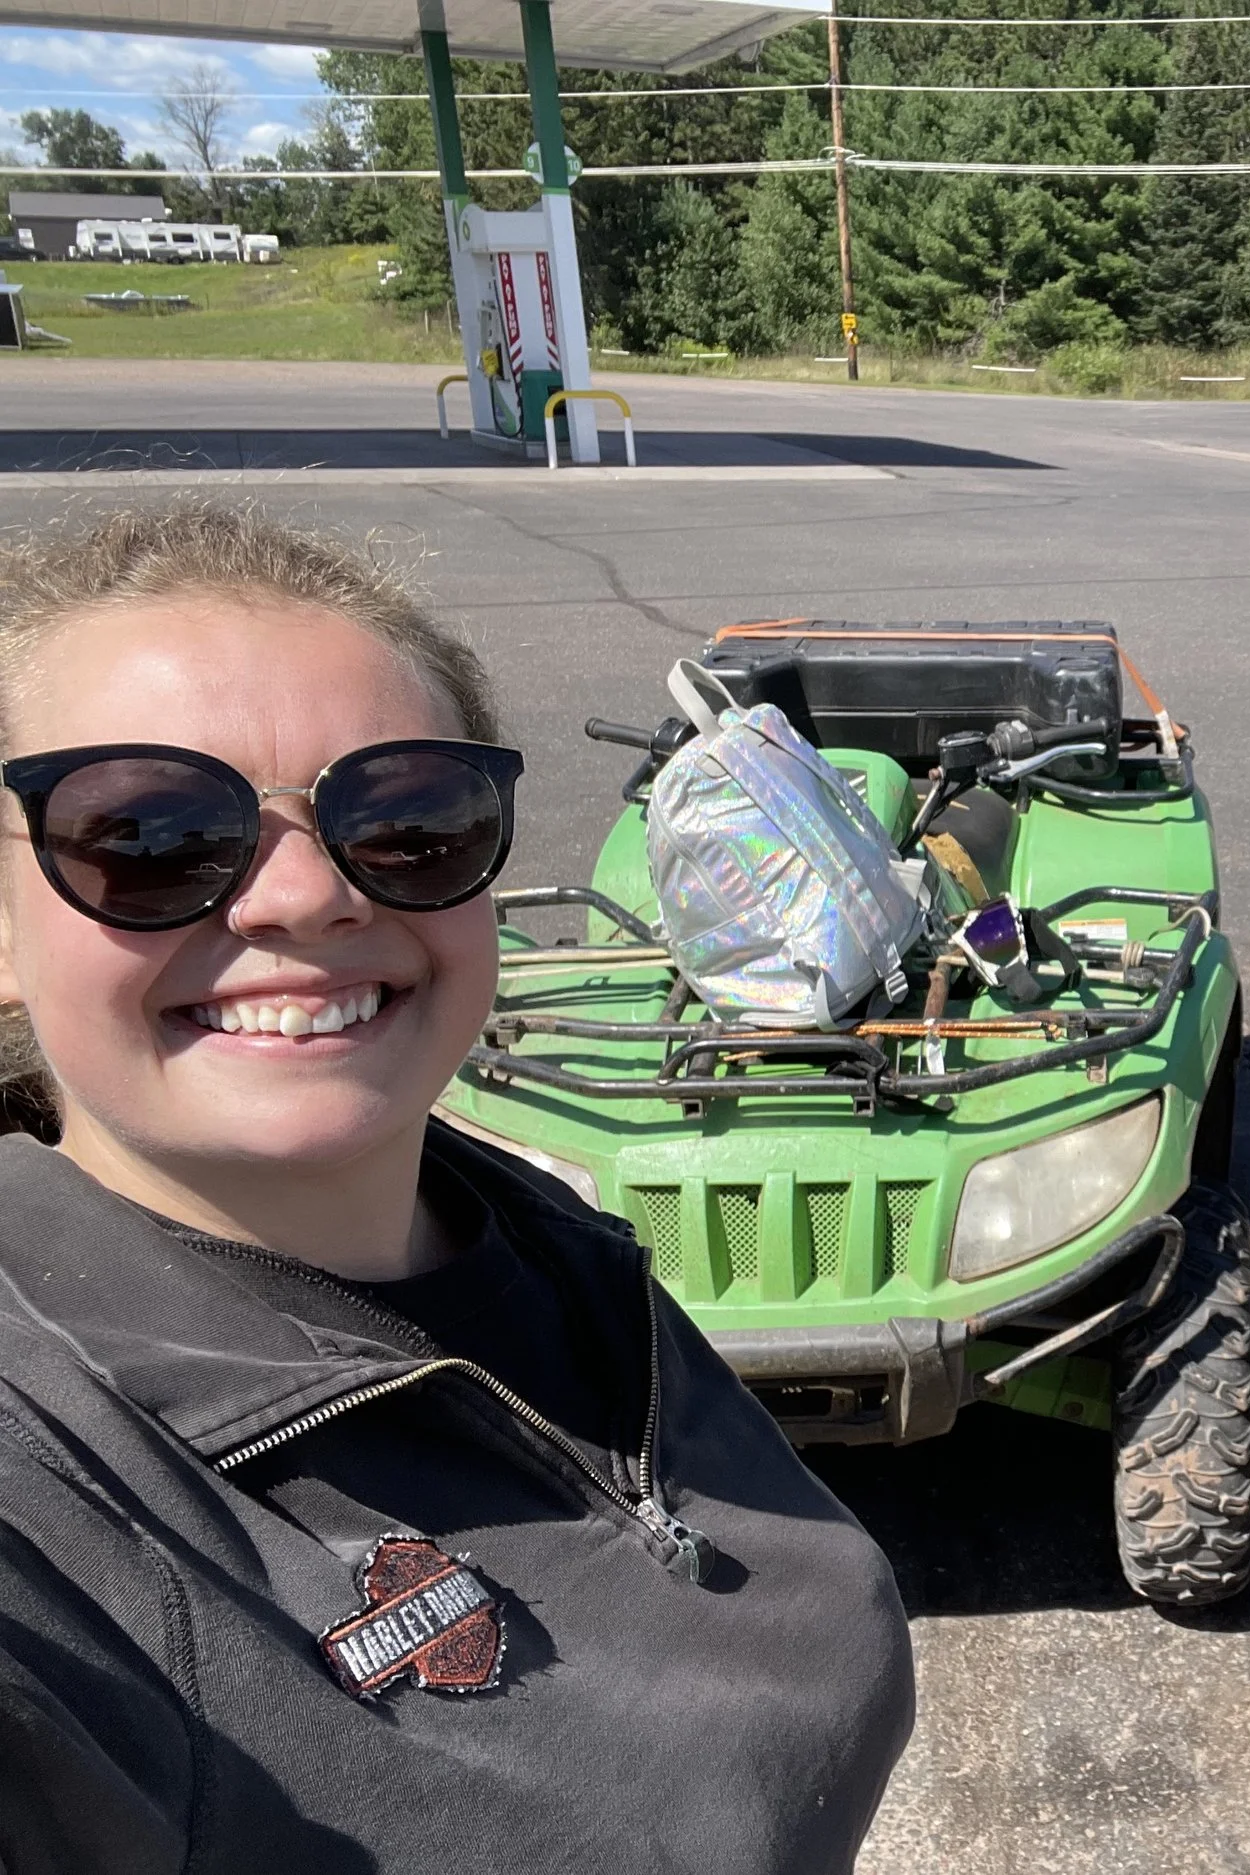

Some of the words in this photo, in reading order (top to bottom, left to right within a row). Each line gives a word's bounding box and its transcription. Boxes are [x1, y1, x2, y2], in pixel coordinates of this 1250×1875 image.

[527, 155, 535, 169] 9
[567, 159, 581, 172] 10
[501, 254, 509, 280] PAY
[507, 303, 518, 338] PUMP
[544, 303, 554, 338] PUMP
